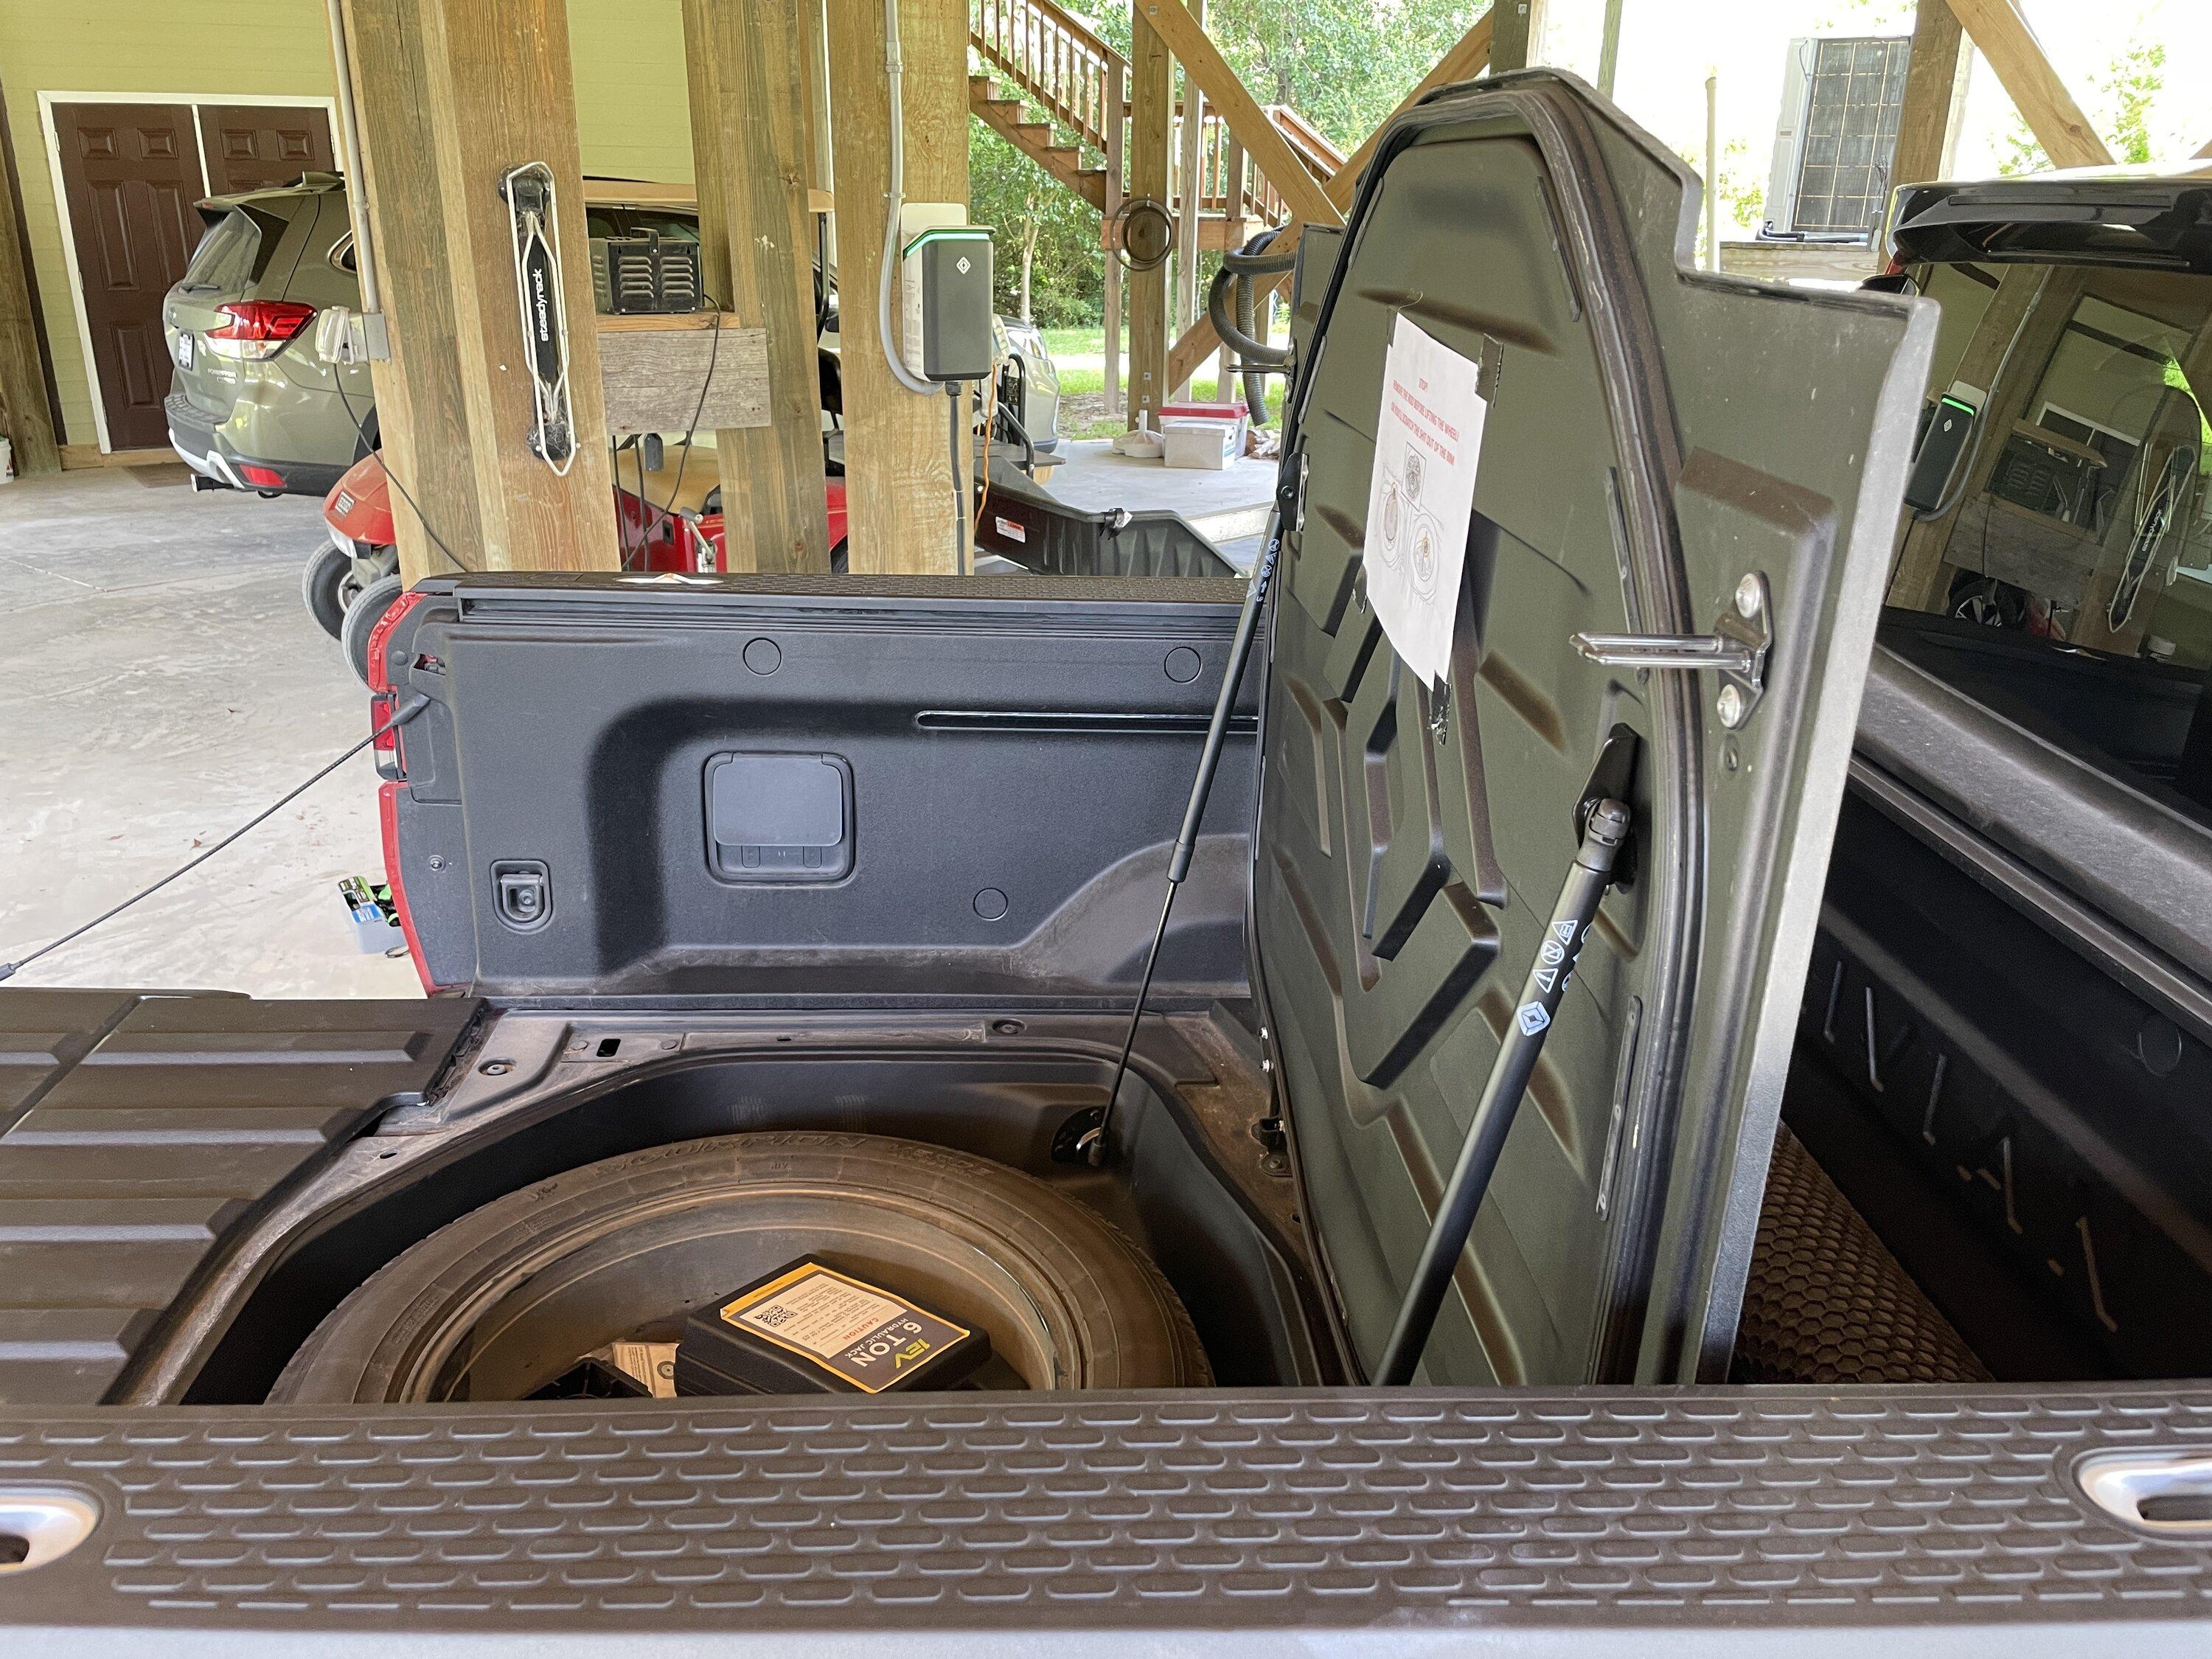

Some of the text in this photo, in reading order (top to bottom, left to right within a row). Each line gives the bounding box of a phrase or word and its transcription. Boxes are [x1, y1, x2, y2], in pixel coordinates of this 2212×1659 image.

[532, 268, 549, 341] steadyrack
[1437, 417, 1445, 431] THE
[1426, 435, 1434, 449] OUT
[1433, 442, 1440, 453] OF
[843, 1318, 879, 1340] CAUTION
[845, 1318, 908, 1358] HYDRAULIC JACK
[850, 1322, 922, 1367] 6 TON
